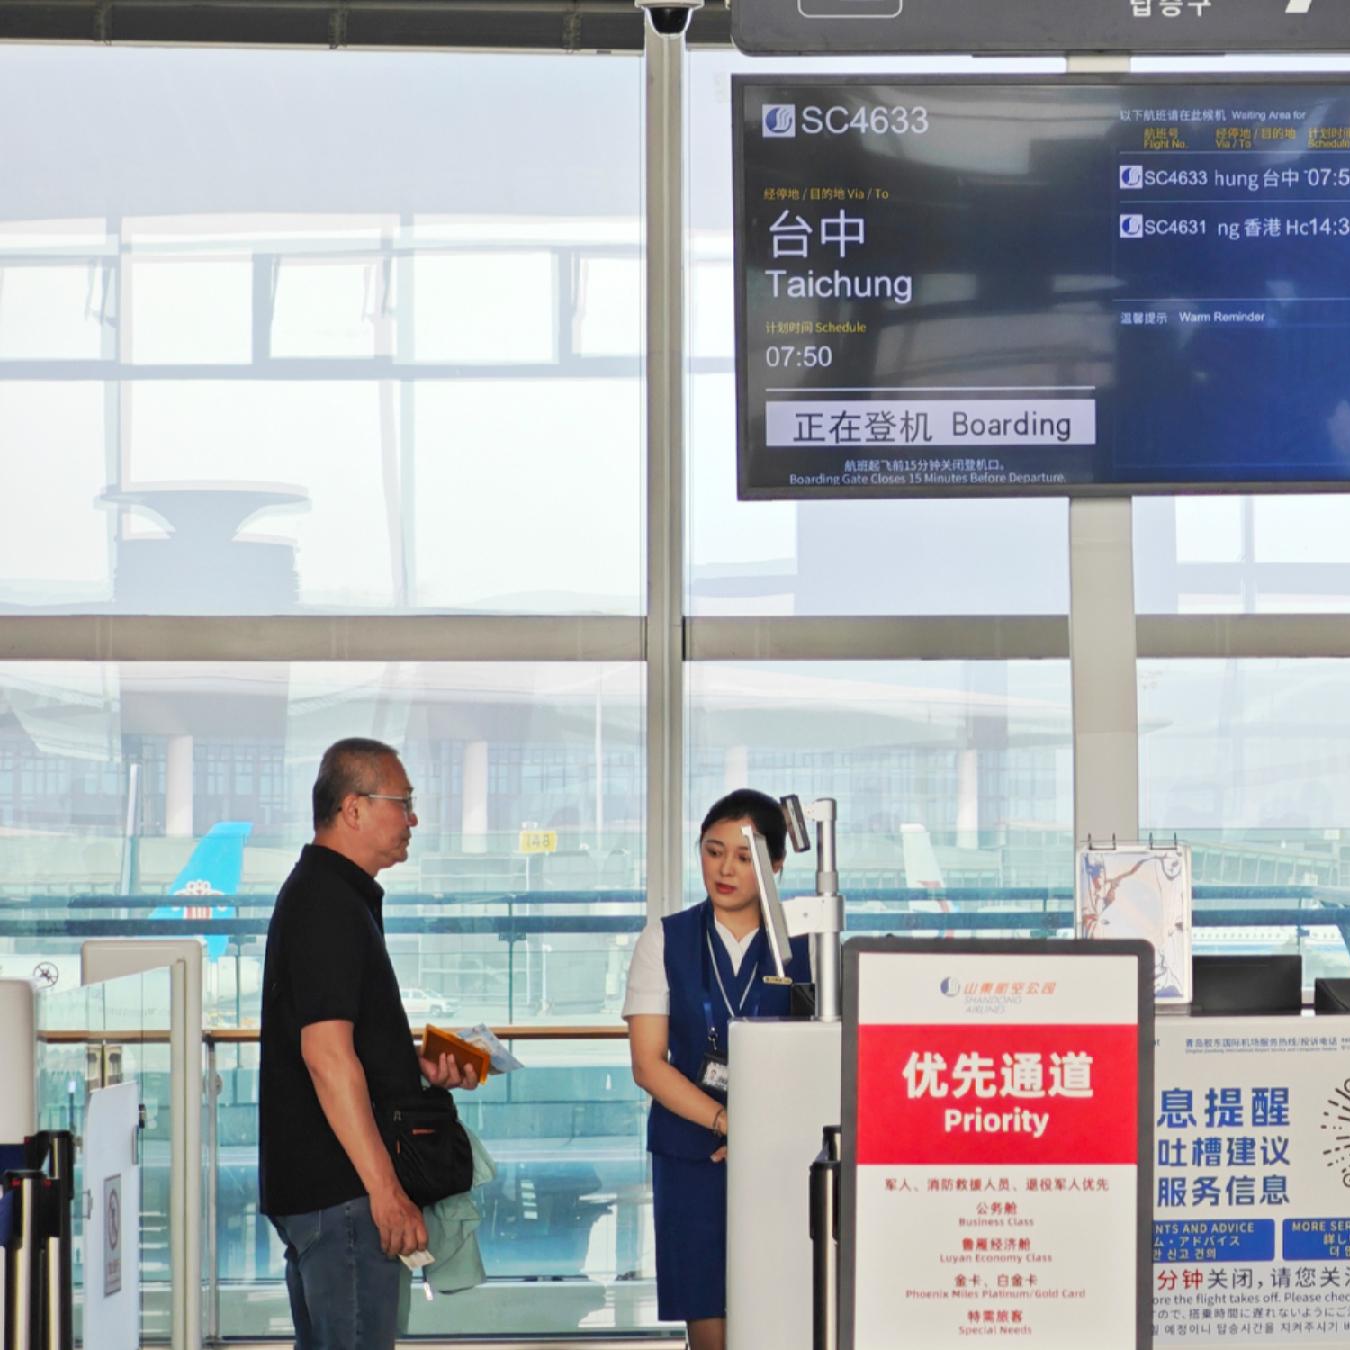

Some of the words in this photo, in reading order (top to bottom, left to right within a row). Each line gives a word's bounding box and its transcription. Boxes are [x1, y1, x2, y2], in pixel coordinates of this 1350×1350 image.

[801, 105, 930, 135] SC4633
[1119, 109, 1226, 122] 以下航班请在此候机
[1231, 110, 1266, 122] Waiting
[1268, 110, 1291, 120] Area
[1292, 110, 1306, 120] for
[1144, 139, 1169, 149] Flight
[1216, 139, 1231, 149] Via
[1240, 139, 1252, 149] To
[1144, 170, 1208, 186] SC4633
[1215, 169, 1259, 192] hung
[1263, 168, 1299, 188] 台中
[764, 187, 800, 200] 经停地
[810, 187, 846, 200] 目的地
[847, 188, 865, 199] Via
[874, 188, 889, 199] To
[769, 208, 865, 259] 台中
[1144, 219, 1206, 235] SC4631
[1218, 222, 1240, 240] ng
[1244, 217, 1281, 238] 香港
[764, 269, 912, 304] Taichung
[1120, 311, 1168, 325] 温馨提示
[1178, 312, 1211, 322] Warm
[1213, 311, 1266, 322] Reminder
[766, 320, 813, 336] 计划时间
[814, 320, 867, 334] Schedule
[766, 345, 833, 367] 07:50
[793, 409, 933, 444] 正在登机
[952, 410, 1071, 442] Boarding
[844, 458, 1005, 473] 航班起飞前15分钟关闭登机口。
[788, 473, 840, 485] Boarding
[841, 473, 868, 485] Gate
[870, 473, 906, 485] Closes
[908, 473, 923, 484] 15
[924, 472, 968, 485] Minutes
[969, 472, 1006, 483] Before
[1008, 472, 1067, 484] Departure.
[902, 1051, 1094, 1099] 优先通道
[1156, 1086, 1291, 1128] 息提醒
[944, 1106, 1050, 1139] Priority
[1157, 1136, 1291, 1167] 吐槽建议
[885, 1178, 1110, 1193] 军人、消防救援人员、退役军人优先
[1157, 1174, 1290, 1208] 服务信息
[975, 1201, 1018, 1215] 公务舱
[958, 1217, 1005, 1227] Business
[1007, 1217, 1035, 1227] Class
[1155, 1223, 1179, 1234] NTS
[1182, 1223, 1208, 1234] AND
[1210, 1222, 1255, 1234] ADVICE
[1291, 1220, 1327, 1231] MORE
[962, 1237, 1031, 1251] 鲁雁经济舱
[1328, 1246, 1340, 1257] 더
[939, 1254, 973, 1265] Luyan
[975, 1254, 1022, 1265] Economy
[1025, 1253, 1053, 1263] Class
[954, 1273, 1038, 1288] 金卡、白金卡
[905, 1289, 949, 1299] Phoenix
[951, 1289, 979, 1298] Miles
[982, 1289, 1059, 1298] Platinum/Gold
[1061, 1289, 1086, 1298] Card
[1173, 1293, 1194, 1305] the
[1196, 1293, 1227, 1306] flight
[1229, 1292, 1260, 1303] takes
[1262, 1293, 1282, 1303] off.
[1284, 1291, 1321, 1303] Please
[967, 1310, 1023, 1323] 特需旅客
[958, 1325, 997, 1337] Special
[1000, 1324, 1032, 1335] Needs
[1164, 1323, 1212, 1336] 예정이니
